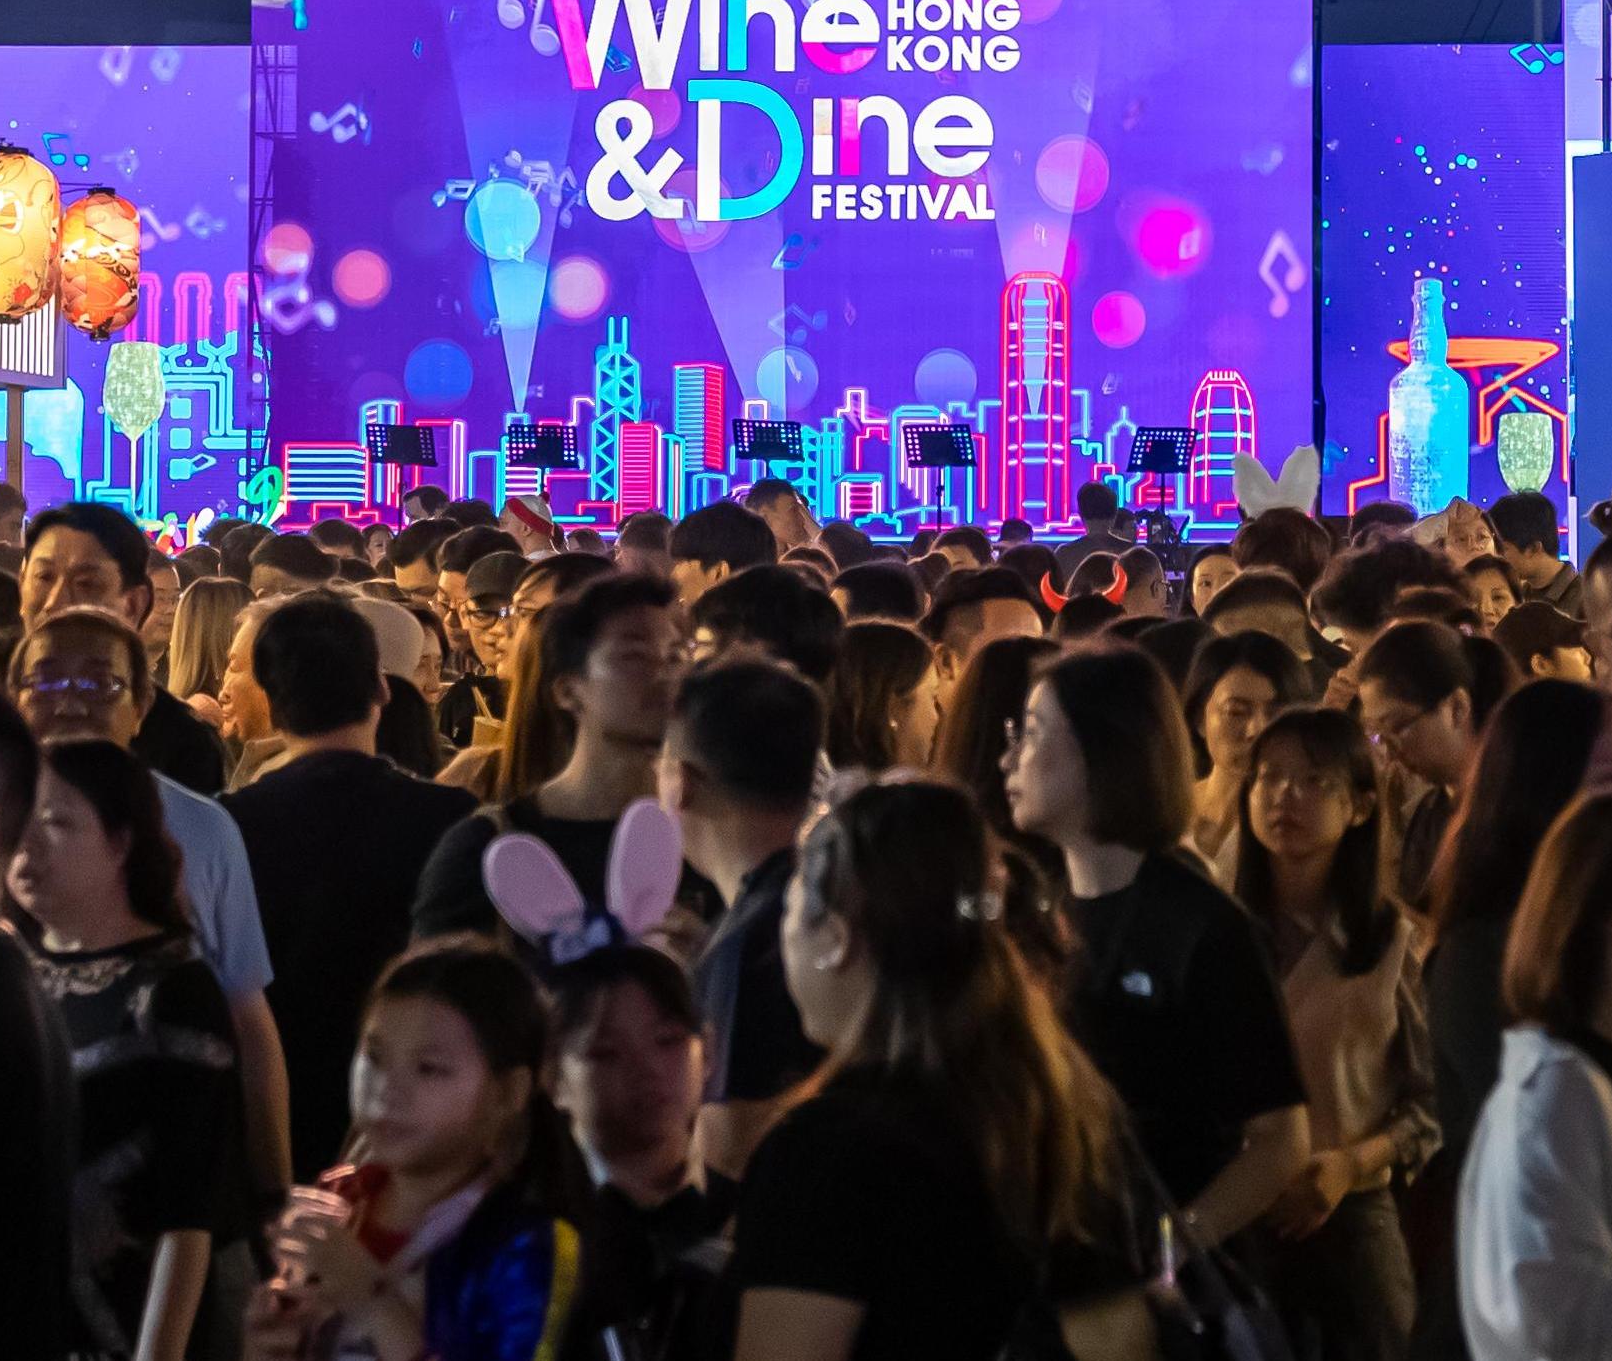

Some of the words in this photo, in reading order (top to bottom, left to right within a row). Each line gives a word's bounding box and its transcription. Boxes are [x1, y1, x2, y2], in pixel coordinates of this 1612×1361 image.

[888, 36, 1021, 72] KONG
[585, 100, 684, 221] &
[688, 79, 994, 221] Dine
[812, 184, 995, 219] FESTIVAL
